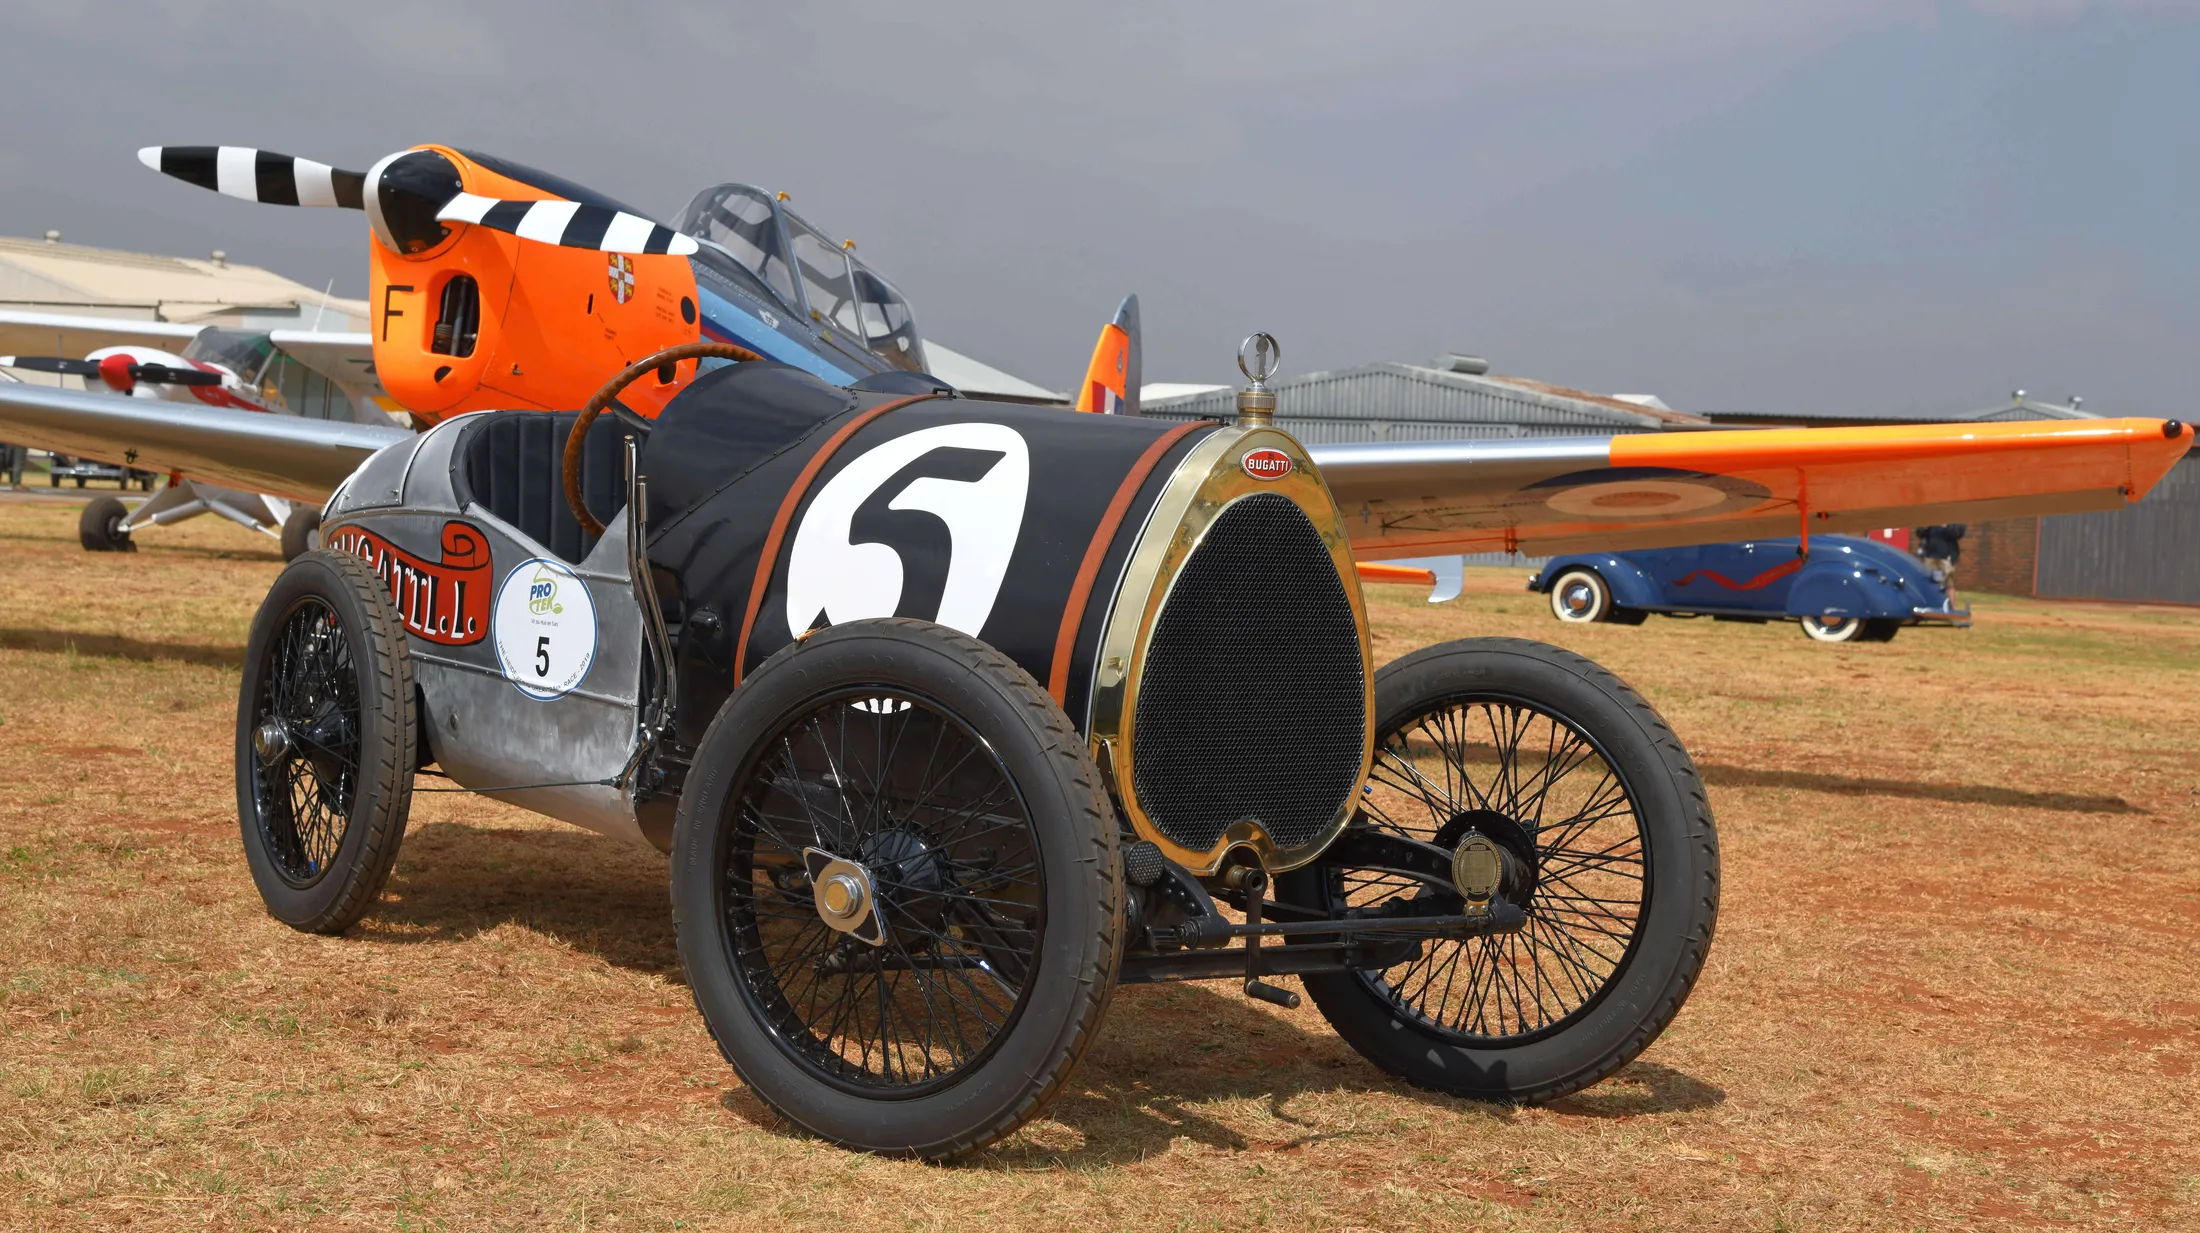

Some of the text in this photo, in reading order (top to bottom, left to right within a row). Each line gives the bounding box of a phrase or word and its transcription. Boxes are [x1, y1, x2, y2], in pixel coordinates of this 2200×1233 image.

[383, 285, 414, 342] F
[1248, 459, 1288, 472] BUGATTI
[530, 583, 551, 601] PRO
[536, 636, 550, 677] 5
[564, 671, 578, 687] RACE
[580, 652, 591, 671] 2019
